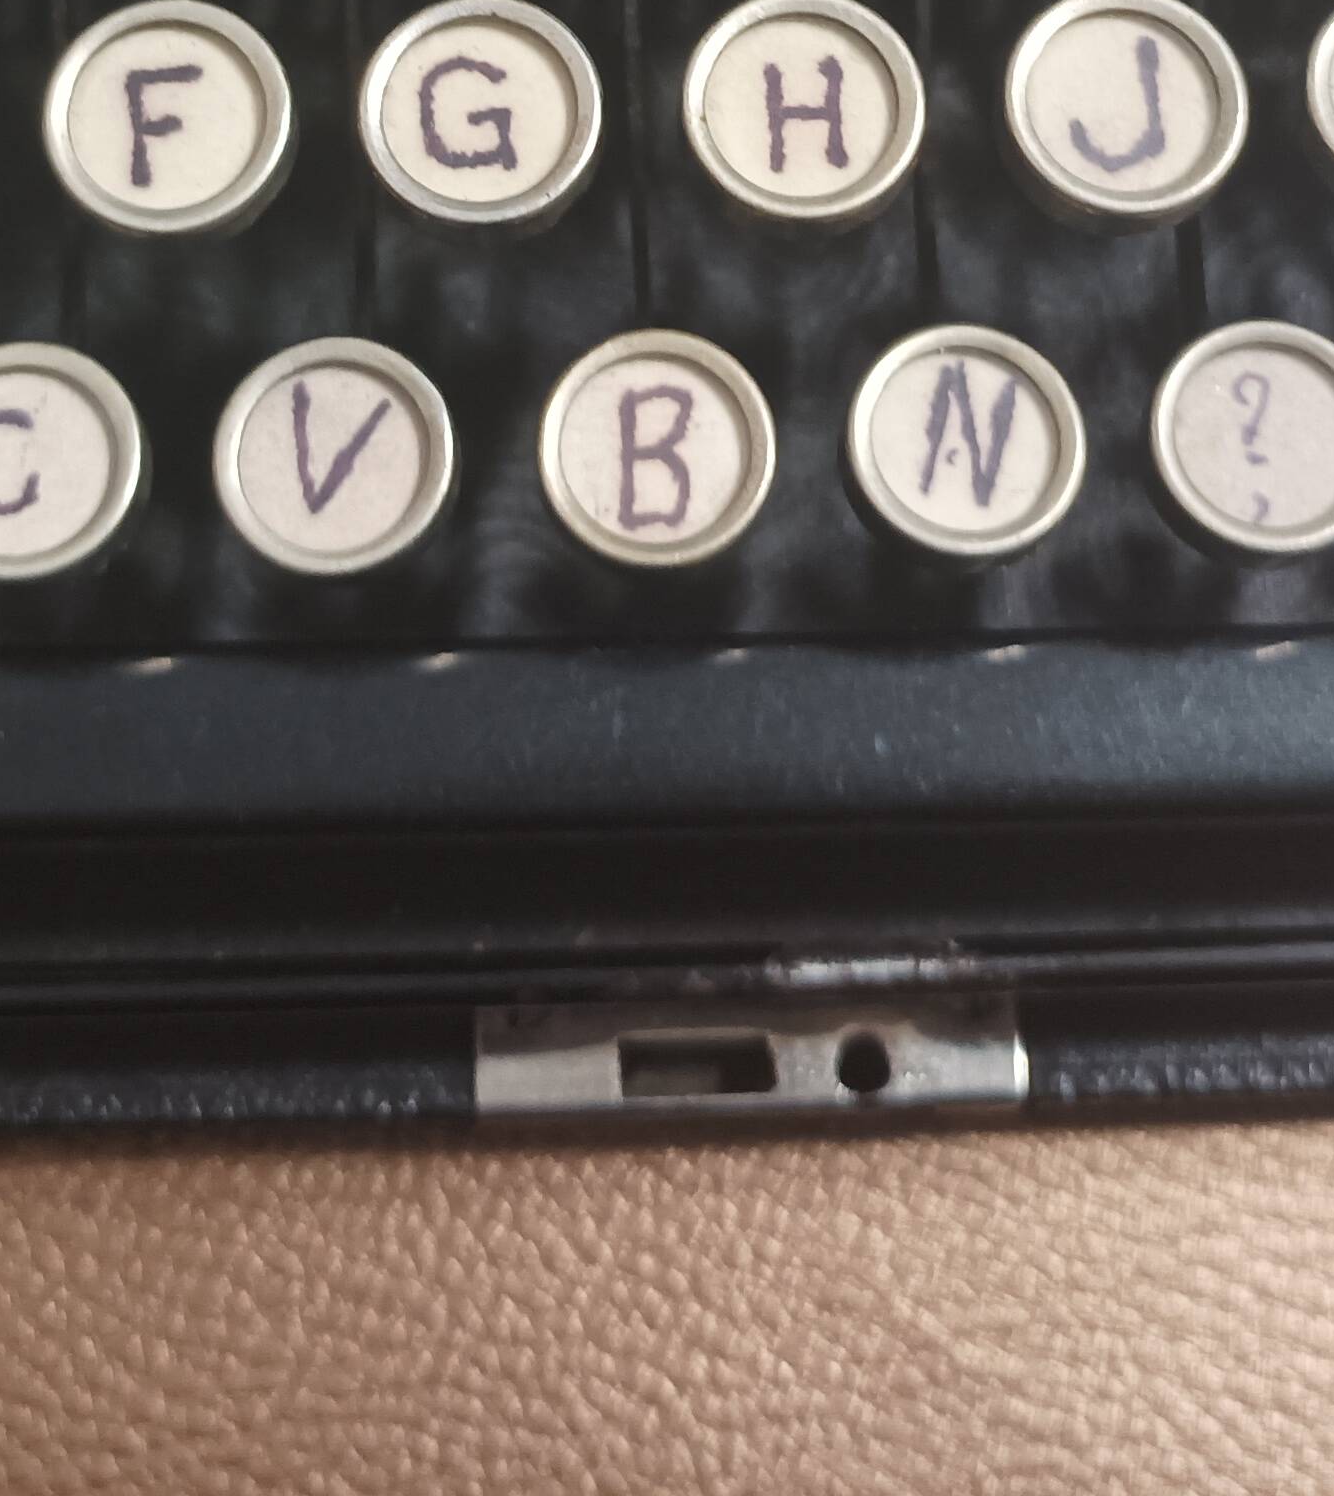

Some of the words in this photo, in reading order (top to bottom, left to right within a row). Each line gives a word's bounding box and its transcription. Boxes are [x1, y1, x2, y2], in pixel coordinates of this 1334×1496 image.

[124, 64, 203, 188] F
[417, 55, 518, 171] G
[763, 55, 849, 174] H
[1069, 36, 1165, 174] J
[292, 381, 391, 515] V
[618, 384, 694, 531] B
[919, 359, 1018, 509] N
[1231, 371, 1270, 466] ?
